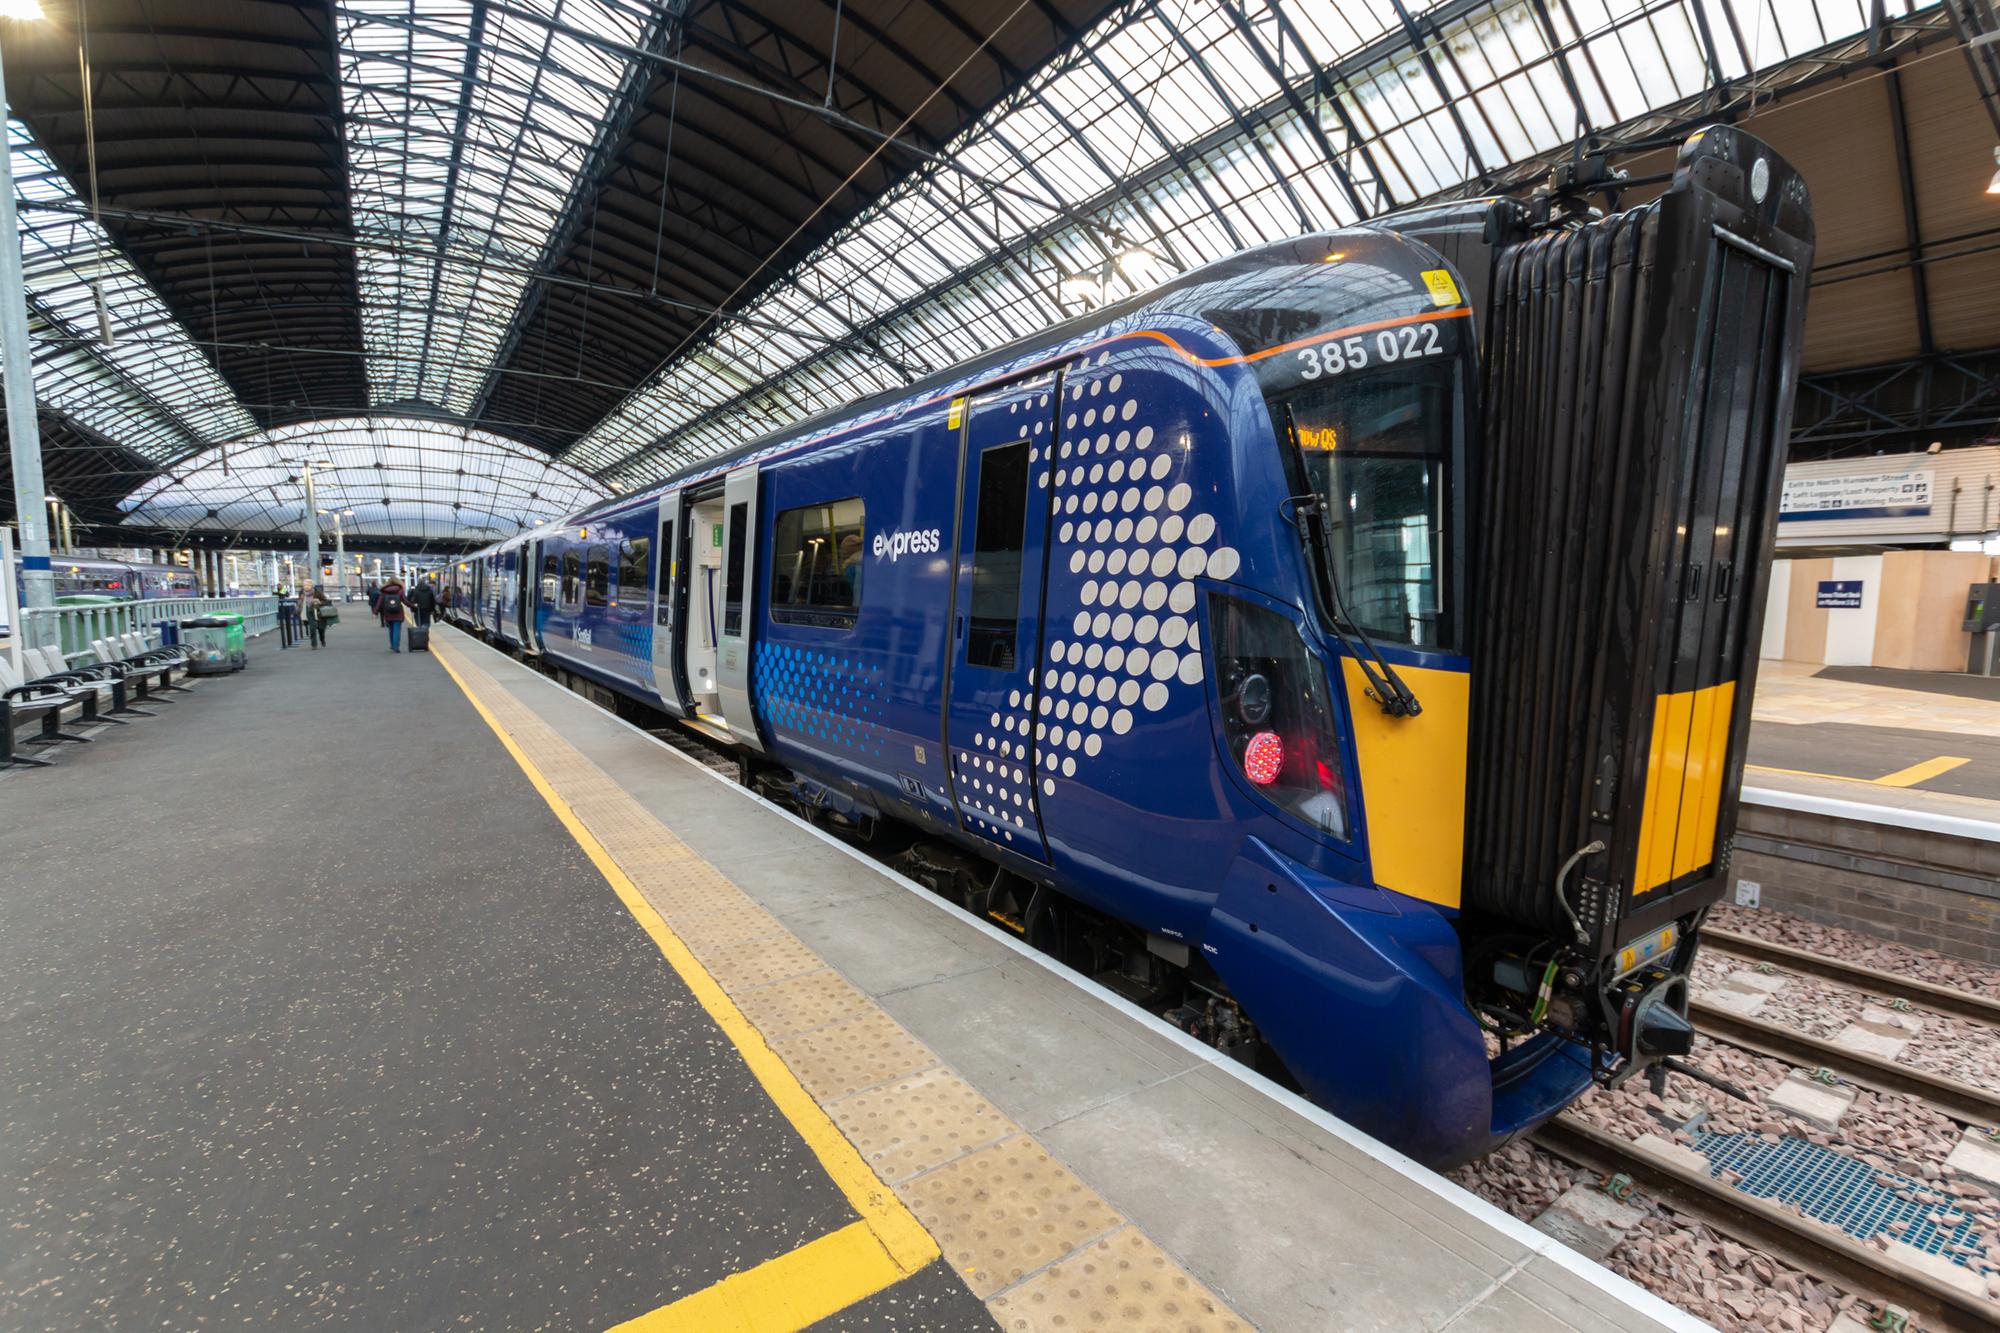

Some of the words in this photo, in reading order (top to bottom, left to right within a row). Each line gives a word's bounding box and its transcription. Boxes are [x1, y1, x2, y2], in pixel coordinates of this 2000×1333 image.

[1297, 336, 1368, 380] 385
[1376, 322, 1443, 363] 022
[1789, 480, 1804, 488] Exit
[1806, 480, 1815, 488] to
[1817, 478, 1840, 487] North
[1881, 472, 1909, 482] Street
[1865, 486, 1899, 496] Property
[1888, 495, 1913, 504] Room
[873, 527, 940, 564] express
